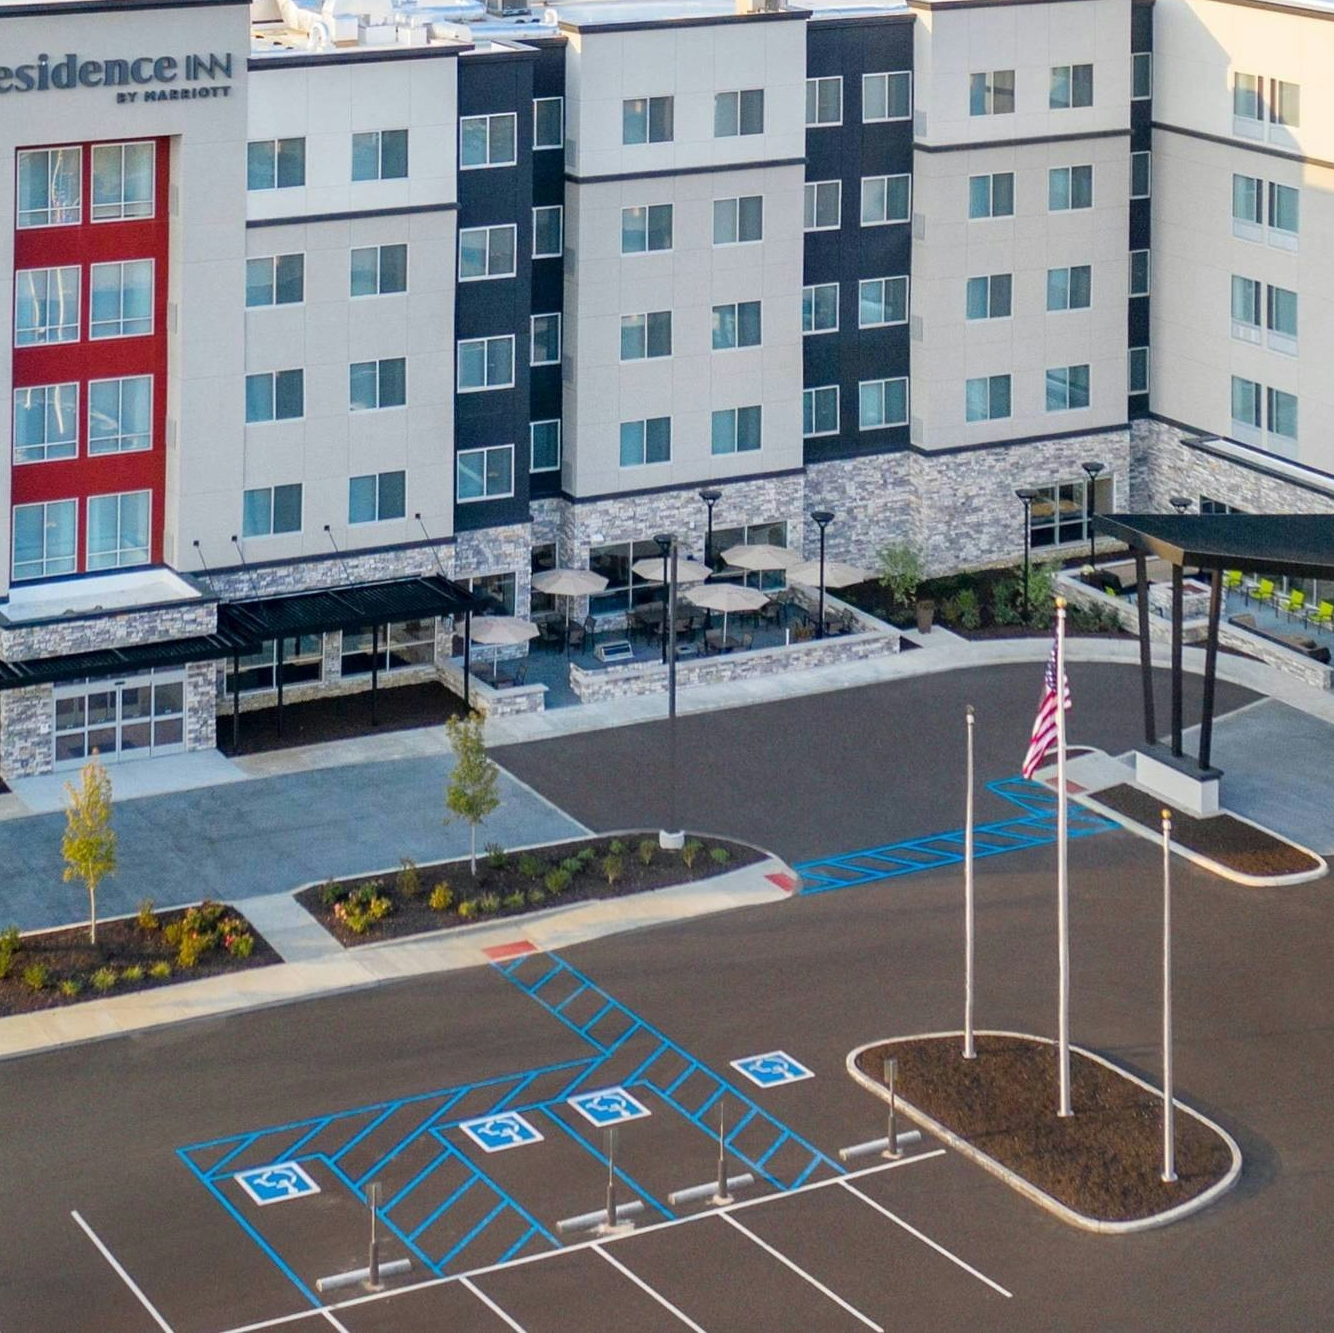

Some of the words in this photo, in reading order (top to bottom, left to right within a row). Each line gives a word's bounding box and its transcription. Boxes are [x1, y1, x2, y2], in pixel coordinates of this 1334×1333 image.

[184, 52, 232, 81] INN
[116, 91, 137, 104] BY
[144, 85, 232, 100] MARRIOTT
